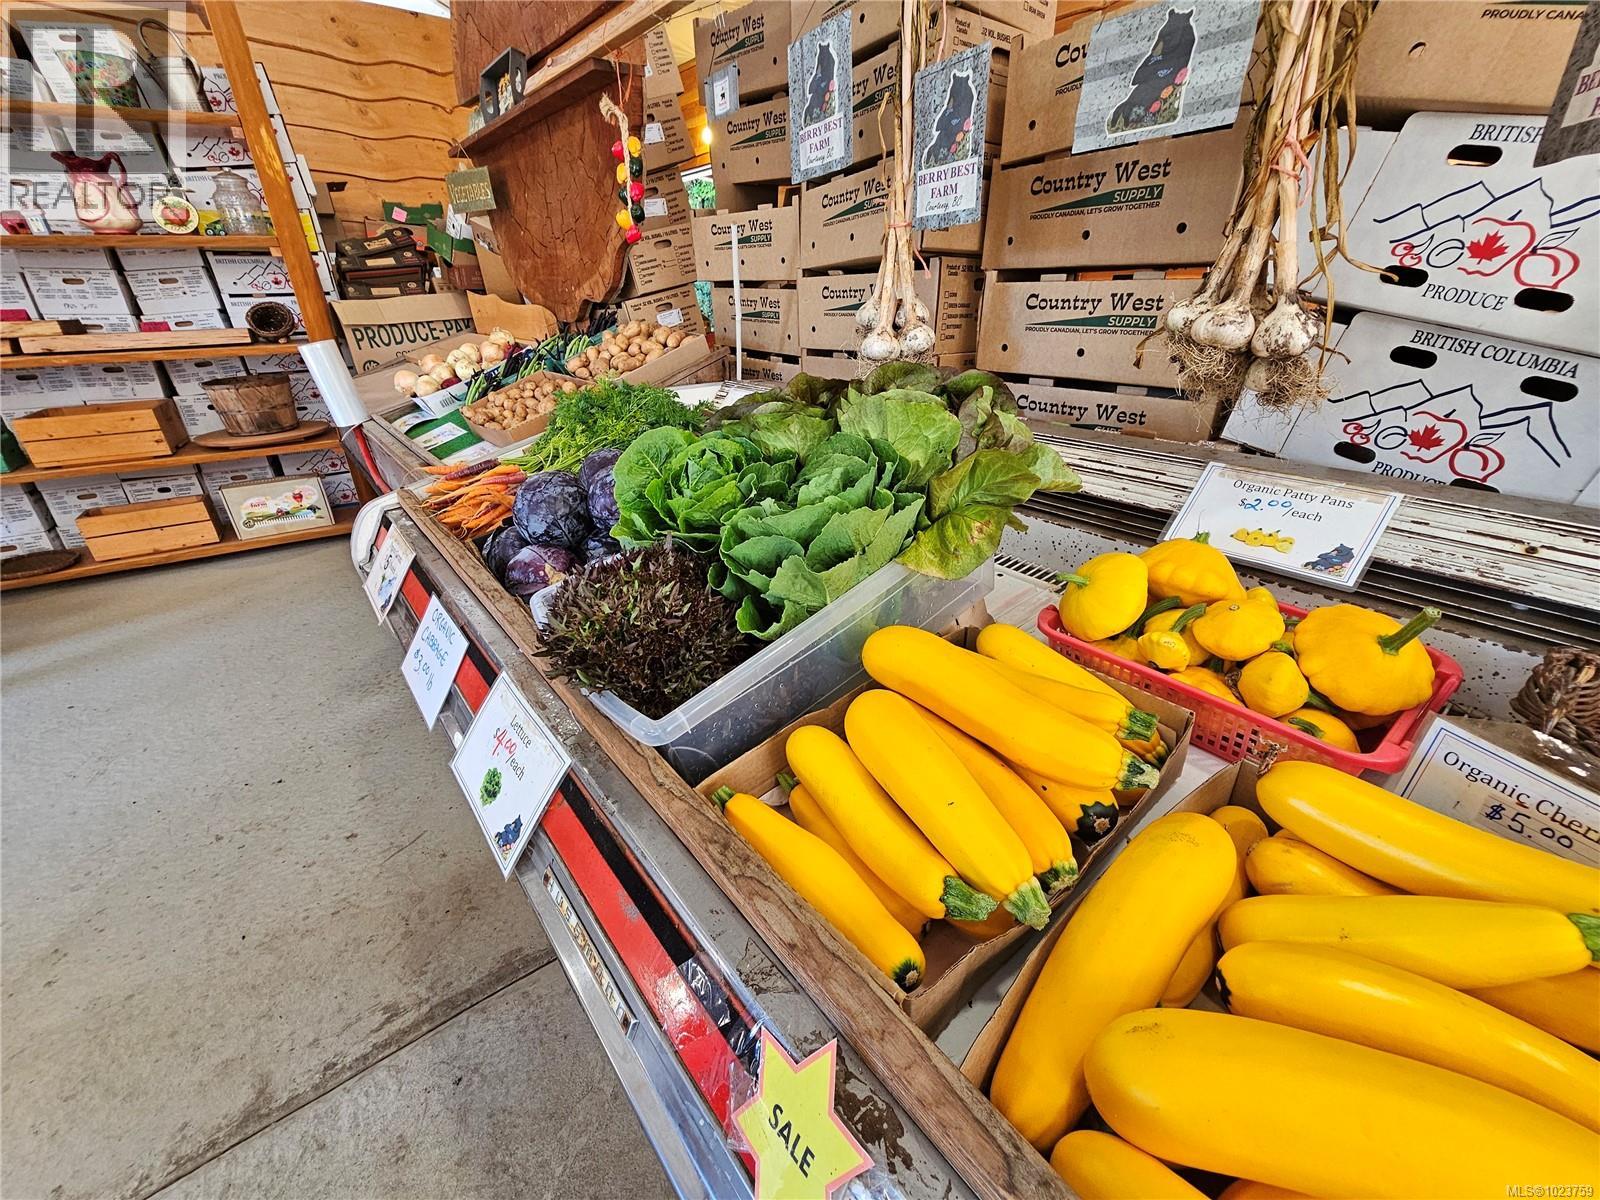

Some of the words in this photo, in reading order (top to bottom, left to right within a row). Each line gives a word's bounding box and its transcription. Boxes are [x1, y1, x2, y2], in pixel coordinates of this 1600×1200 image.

[1481, 9, 1545, 20] PROUDLY
[711, 23, 740, 47] Country
[742, 13, 765, 34] West
[745, 31, 764, 47] SUPPLY
[727, 117, 760, 135] Country
[763, 110, 787, 126] West
[765, 128, 786, 139] SUPPLY
[800, 128, 824, 145] BERRY
[824, 118, 843, 136] BEST
[809, 137, 831, 154] FARM
[918, 169, 950, 186] BERRY
[950, 162, 977, 178] BEST
[1030, 172, 1107, 195] Country
[1114, 158, 1172, 183] West
[448, 182, 491, 205] VEGETABLES
[821, 187, 860, 208] Country
[930, 183, 959, 199] FARM
[1112, 186, 1162, 202] SUPPLY
[1029, 212, 1055, 221] PROUDLY
[1055, 208, 1086, 218] CANADIAN,
[1086, 206, 1102, 215] LET'S
[1103, 204, 1124, 213] GROW
[1125, 201, 1160, 211] TOGETHER
[711, 222, 746, 237] Counry
[748, 219, 773, 232] West
[750, 234, 771, 243] SUPPLY
[760, 296, 781, 309] West
[821, 285, 866, 302] Country
[1025, 293, 1103, 315] Country
[1110, 292, 1165, 312] West
[1420, 283, 1509, 311] PRODUCE
[761, 311, 780, 320] SUPPLY
[1107, 316, 1156, 328] SUPPLY
[1409, 329, 1482, 358] BRITISH
[1481, 344, 1581, 379] COLUMBIA
[762, 367, 783, 381] West
[1016, 394, 1088, 421] Country
[1095, 403, 1147, 425] West
[1233, 479, 1281, 497] Organic
[1283, 486, 1318, 503] Patty
[1320, 493, 1354, 509] Pans
[431, 609, 456, 646] ORGANIC
[420, 626, 450, 668] CABBAGE
[510, 714, 532, 749] Lettuce
[1443, 751, 1531, 806] Organic
[1484, 803, 1574, 850] $5.00
[768, 1103, 816, 1179] SALE
